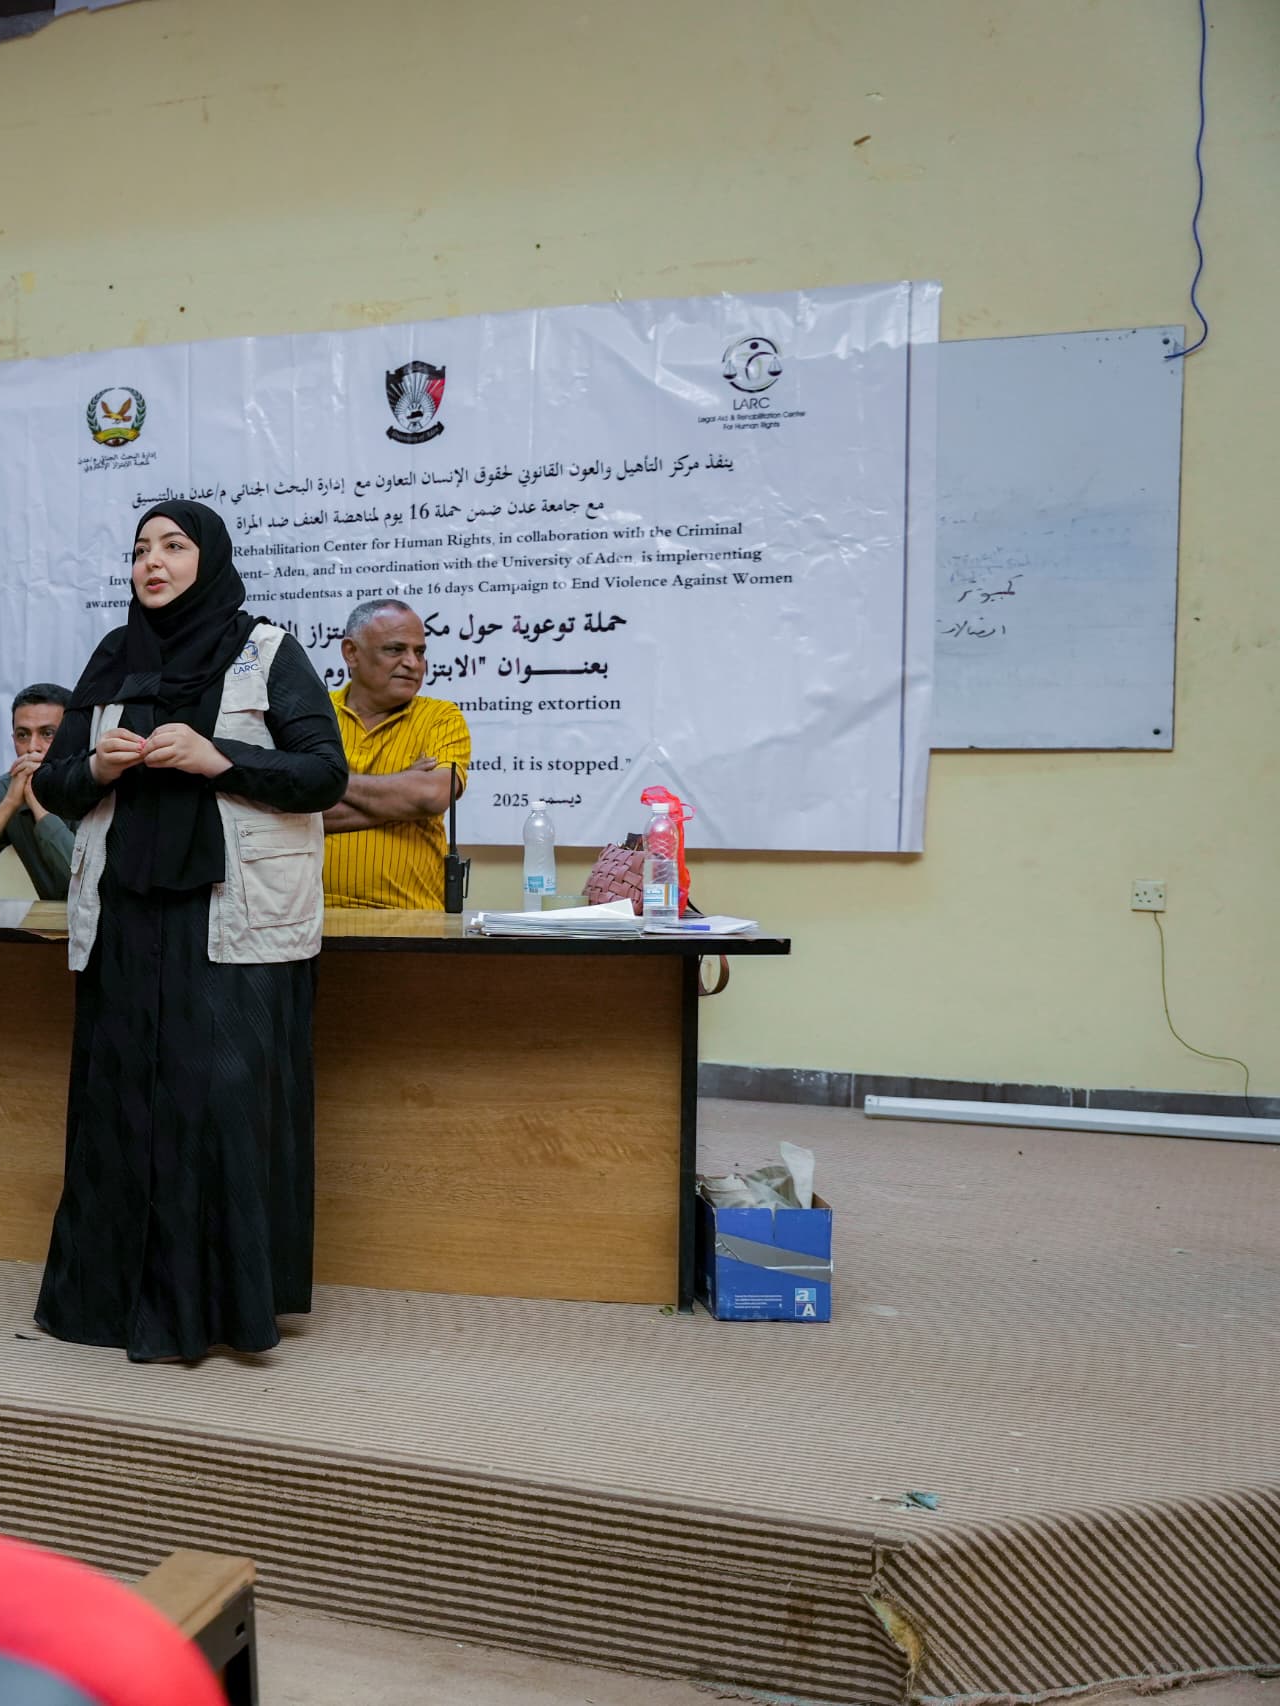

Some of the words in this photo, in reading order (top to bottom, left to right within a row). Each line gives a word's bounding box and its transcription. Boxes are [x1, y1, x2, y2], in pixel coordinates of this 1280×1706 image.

[732, 396, 771, 411] LARC
[569, 460, 612, 482] والعون
[616, 455, 663, 481] التأهيل
[669, 455, 700, 478] مركز
[705, 454, 734, 471] ينفذ
[375, 471, 416, 493] التعاون
[518, 462, 563, 488] القانوني
[230, 481, 269, 505] الجنائي
[273, 477, 313, 496] البحث
[354, 480, 371, 497] مع
[410, 502, 430, 520] 16
[434, 503, 462, 518] حملة
[466, 503, 502, 522] ضمن
[507, 501, 537, 516] عدن
[541, 499, 580, 515] جامعة
[585, 501, 605, 519] مع
[267, 517, 289, 528] ضد
[293, 509, 328, 528] العنف
[383, 514, 403, 529] يوم
[233, 541, 320, 557] Rehabilitation
[323, 540, 368, 552] Center
[371, 537, 391, 550] for
[394, 536, 443, 549] Human
[447, 533, 496, 549] Rights,
[499, 531, 512, 545] in
[516, 528, 609, 544] collaboration
[613, 526, 645, 540] with
[649, 525, 672, 538] the
[676, 522, 743, 537] Criminal
[312, 563, 336, 577] and
[339, 562, 352, 576] in
[355, 559, 440, 574] coordination
[443, 557, 473, 571] with
[476, 556, 498, 569] the
[501, 554, 571, 569] University
[576, 552, 594, 566] of
[641, 550, 653, 563] is
[656, 547, 763, 565] implementing
[246, 590, 277, 602] emic
[346, 590, 353, 598] a
[356, 586, 382, 601] part
[386, 584, 399, 596] of
[403, 583, 423, 596] the
[427, 582, 441, 595] 16
[444, 581, 474, 597] days
[477, 579, 549, 595] Campaign
[552, 579, 567, 590] to
[571, 577, 600, 590] End
[603, 575, 668, 588] Violence
[672, 572, 729, 590] Against
[732, 571, 793, 586] Women
[459, 613, 503, 644] حول
[511, 614, 576, 643] توعوية
[583, 611, 627, 634] حملة
[233, 664, 258, 675] LARC
[459, 696, 533, 716] mbating
[538, 695, 621, 711] extortion
[513, 755, 525, 771] it
[530, 755, 544, 771] is
[492, 793, 530, 807] 2025
